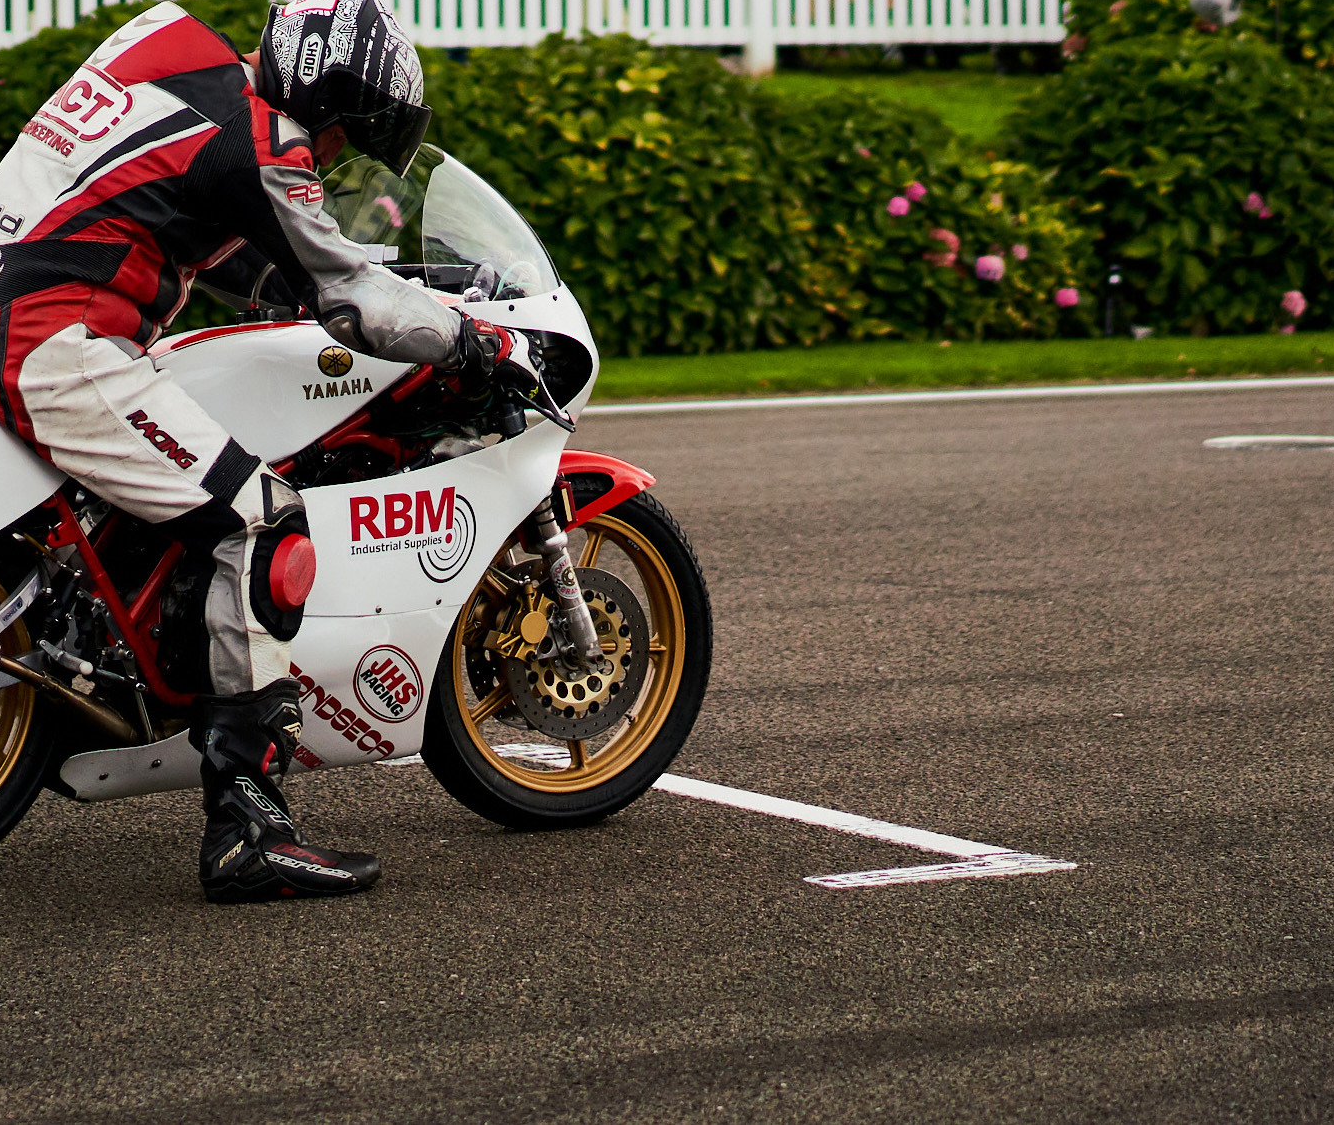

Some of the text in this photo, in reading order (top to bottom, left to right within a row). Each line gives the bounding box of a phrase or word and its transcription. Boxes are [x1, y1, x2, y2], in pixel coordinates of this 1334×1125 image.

[302, 40, 319, 78] SHOEI
[302, 377, 374, 400] YAMAHA
[125, 409, 199, 470] RACING
[349, 486, 455, 542] RBM
[351, 536, 442, 556] Industrial Supplies
[360, 668, 404, 717] RACING
[370, 657, 418, 705] JHS
[235, 776, 294, 830] RST
